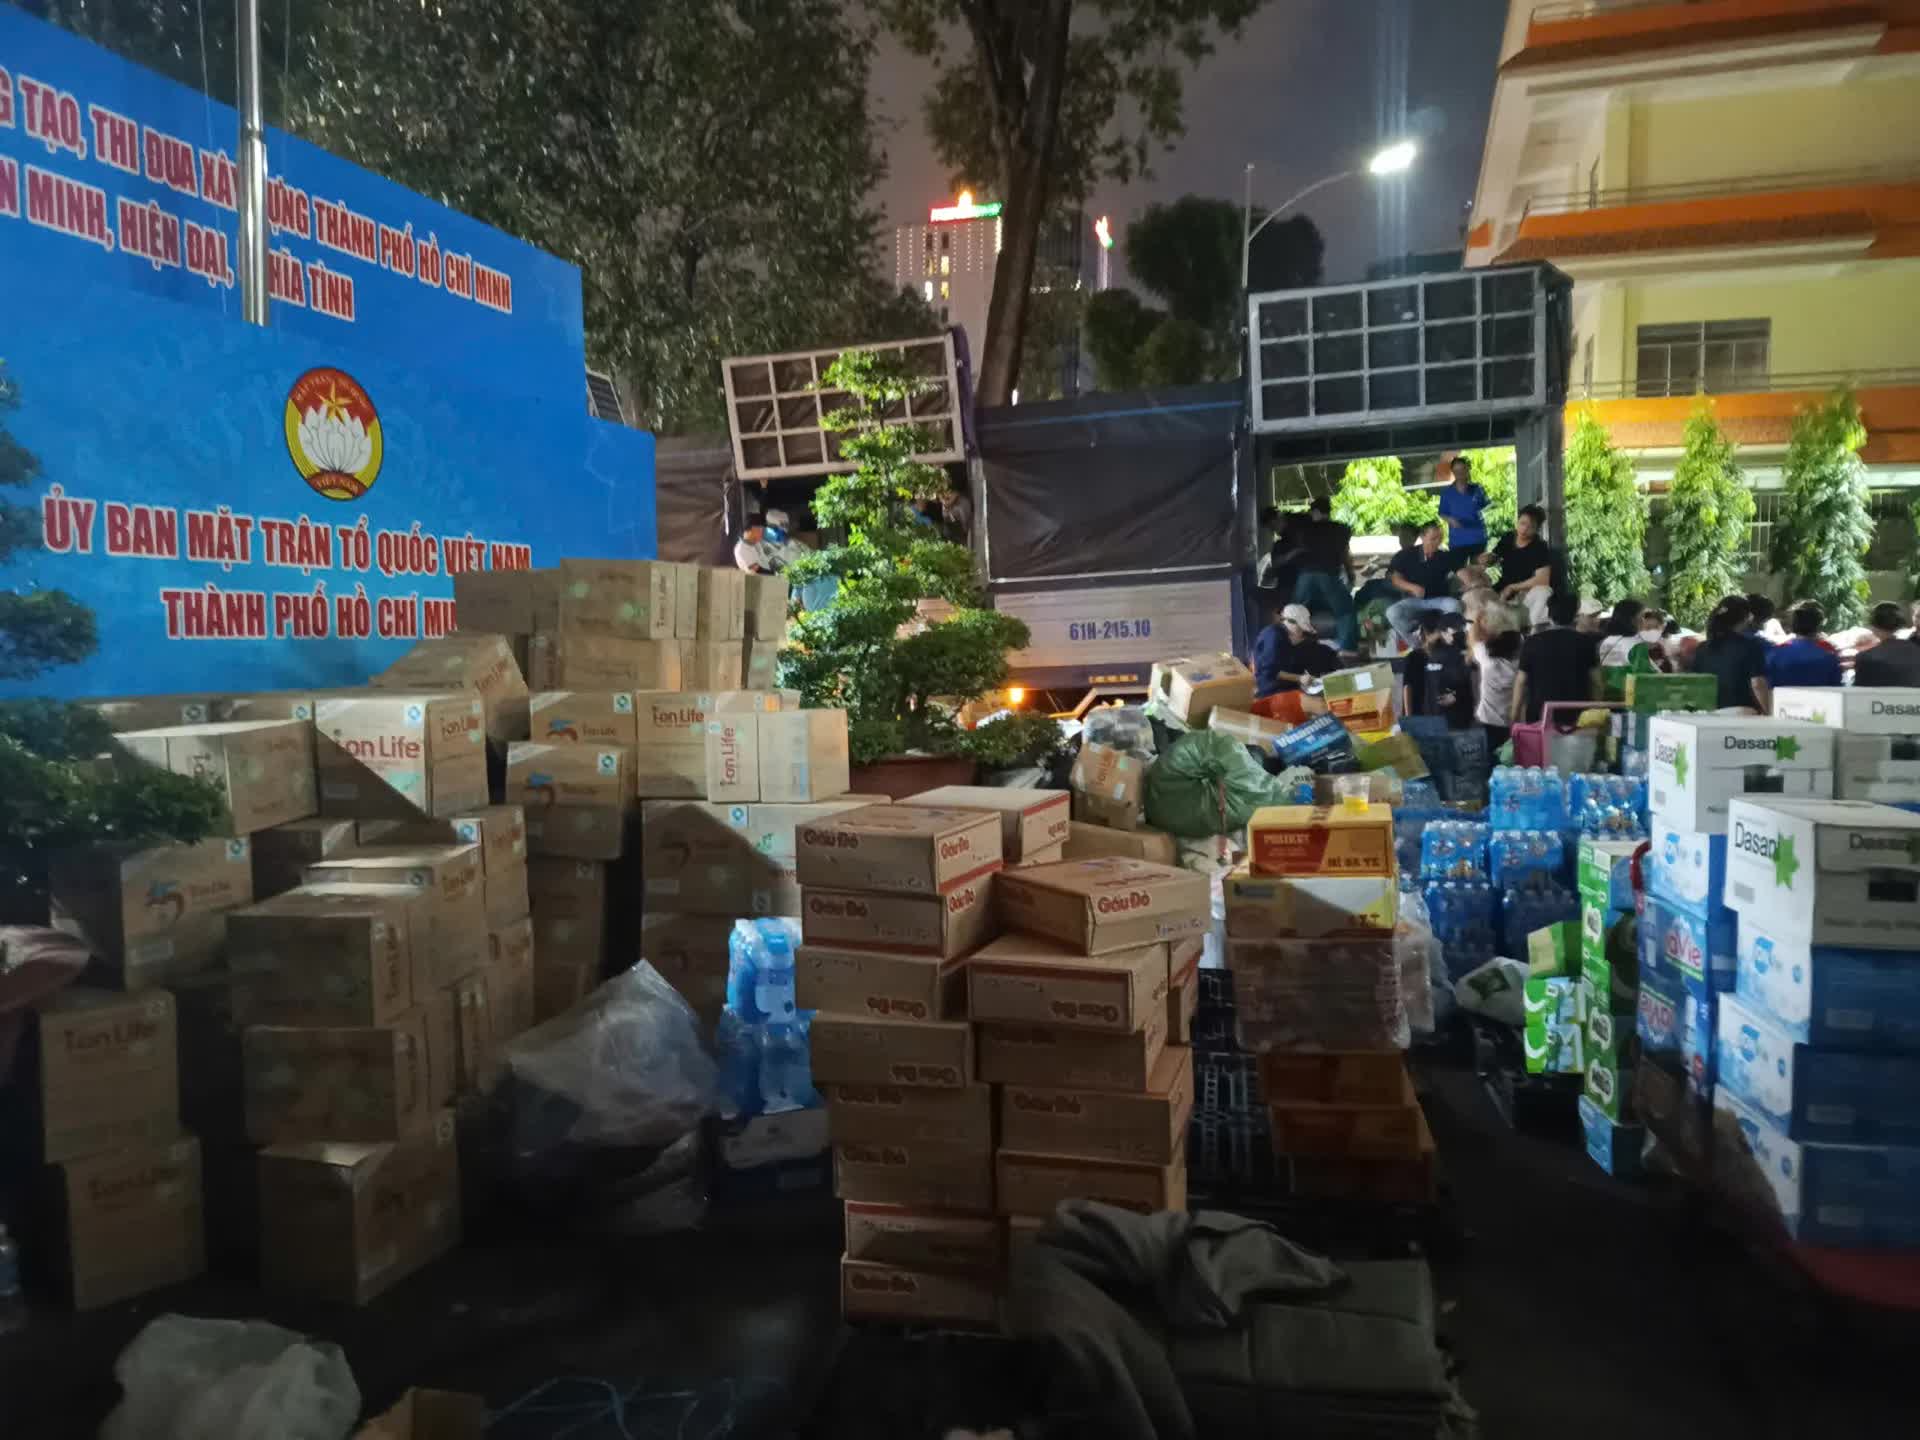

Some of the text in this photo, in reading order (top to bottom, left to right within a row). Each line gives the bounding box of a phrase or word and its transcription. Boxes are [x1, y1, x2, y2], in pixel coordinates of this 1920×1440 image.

[18, 76, 86, 159] TẠO,
[90, 104, 139, 175] THI
[268, 177, 310, 239] ỰNG
[312, 196, 376, 263] THÀNH
[380, 221, 415, 277] PHỐ
[417, 232, 441, 287] HỒ
[444, 251, 472, 299] CHÍ
[474, 262, 512, 313] MINH
[26, 164, 113, 250] MINH,
[118, 197, 181, 271] HIỆN
[185, 219, 234, 289] ĐẠI,
[307, 260, 355, 322] TÌNH
[43, 484, 531, 577] ỦY BAN MẶT TRẬN TỔ QUỐC VIỆT NAM
[161, 583, 266, 639] THÀNH
[274, 580, 328, 639] PHỐ
[336, 582, 370, 639] HỒ
[378, 592, 418, 639] CHÍ
[1069, 619, 1150, 641] 61H-215.10
[380, 736, 420, 759] Life
